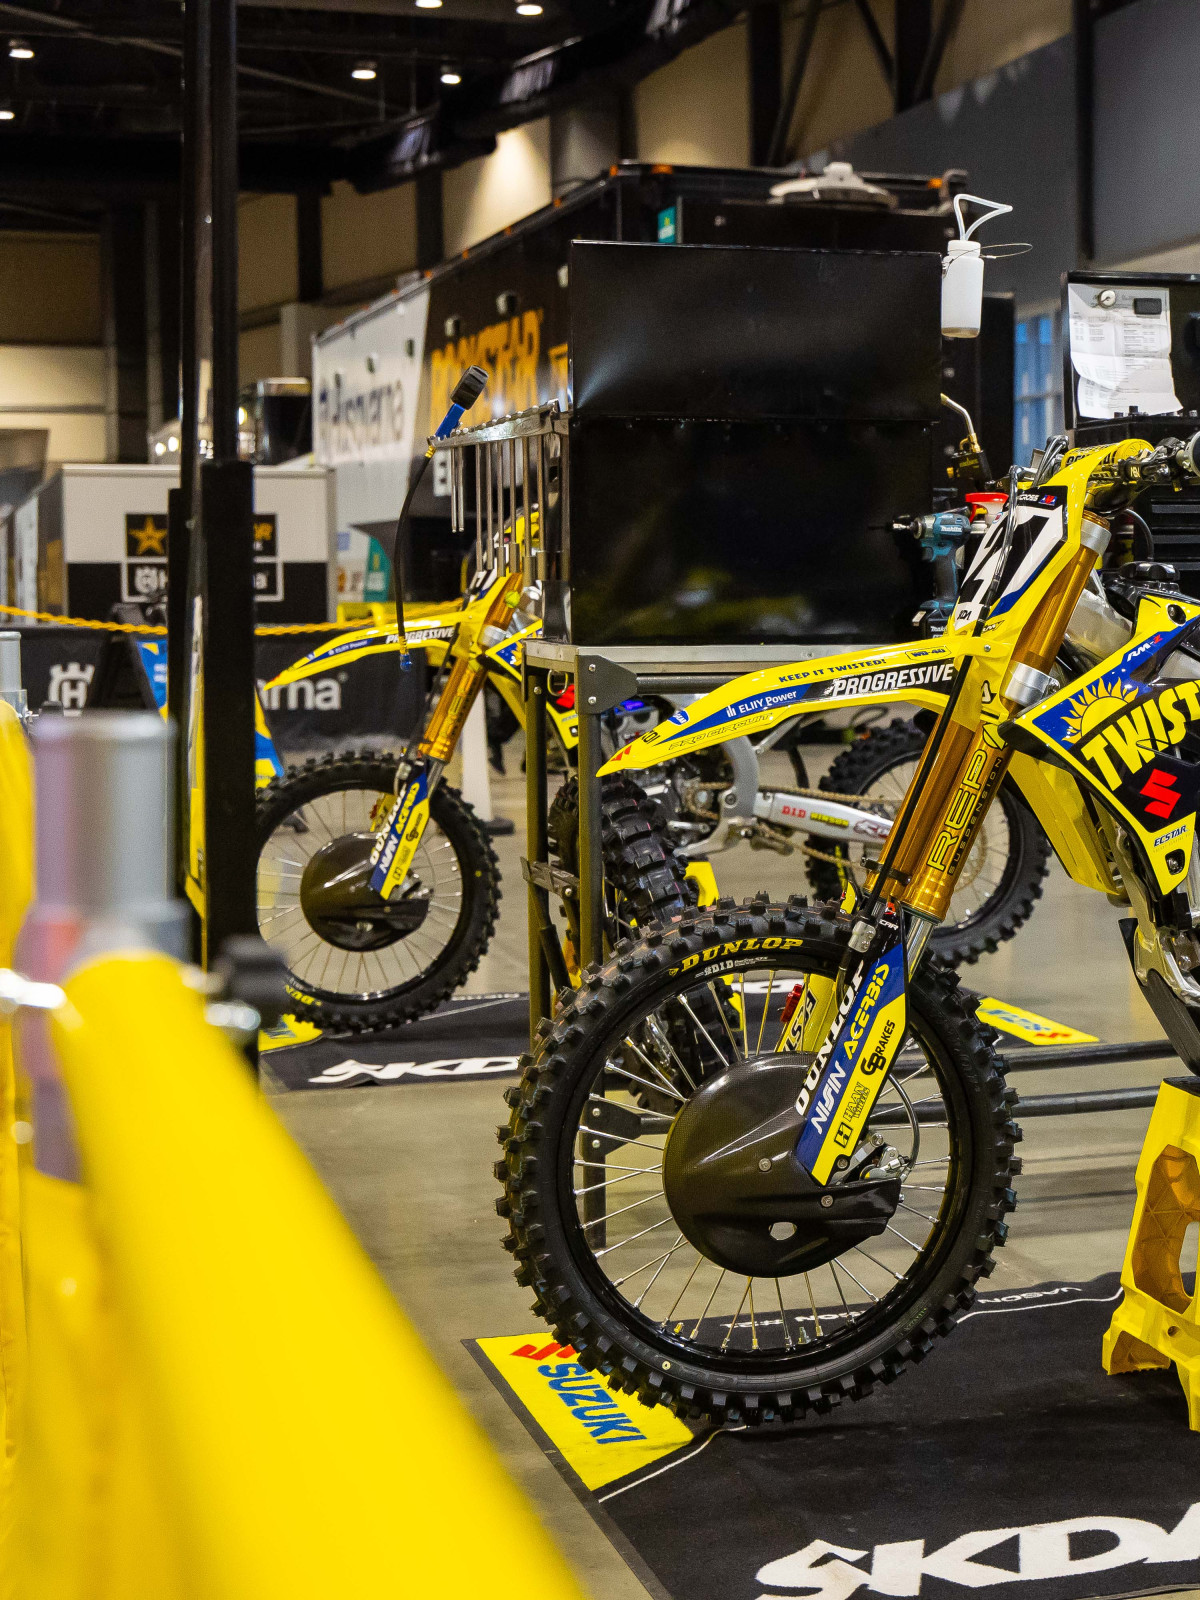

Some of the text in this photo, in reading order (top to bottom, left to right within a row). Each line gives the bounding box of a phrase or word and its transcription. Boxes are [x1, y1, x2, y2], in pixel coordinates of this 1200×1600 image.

[1126, 634, 1163, 662] RM-Z
[778, 659, 886, 683] KEEP IT TWISTED!
[833, 664, 954, 697] PROGRESSIVE
[766, 690, 798, 707] Power
[927, 748, 988, 872] REP
[1154, 825, 1188, 847] ECSTAR
[681, 937, 804, 972] DUNLOP
[795, 960, 864, 1116] DUNLOP
[307, 1056, 530, 1084] SKD
[537, 1362, 648, 1445] SUZUKI
